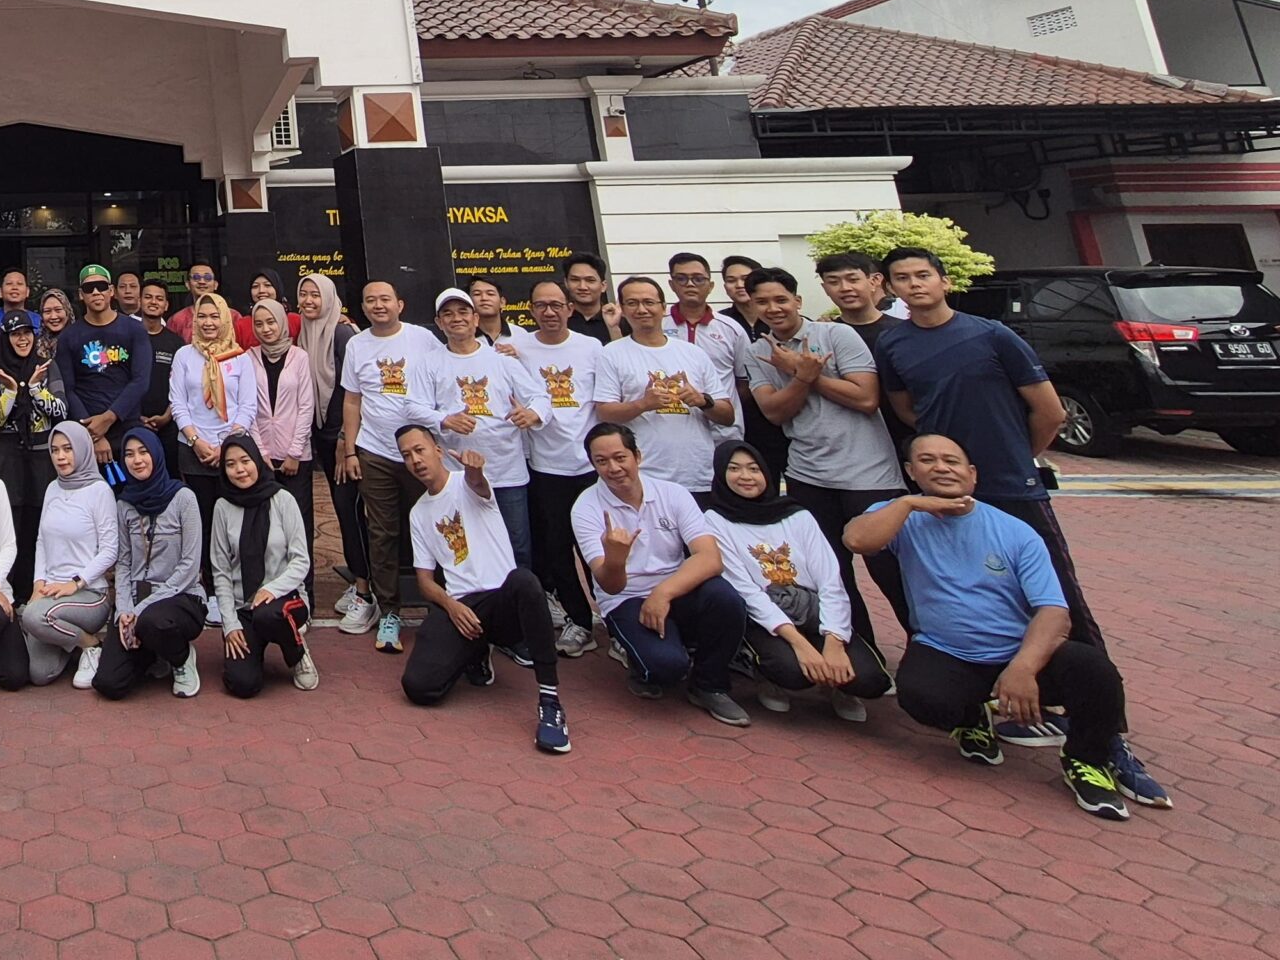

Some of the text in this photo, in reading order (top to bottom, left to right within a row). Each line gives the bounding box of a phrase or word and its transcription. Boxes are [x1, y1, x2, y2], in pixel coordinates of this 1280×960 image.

[312, 254, 331, 264] yang
[460, 248, 495, 260] terhadap
[496, 248, 522, 259] Tuhan
[523, 247, 546, 261] Yang
[456, 265, 488, 276] maupun
[490, 265, 519, 273] sesama
[521, 264, 555, 273] manusia
